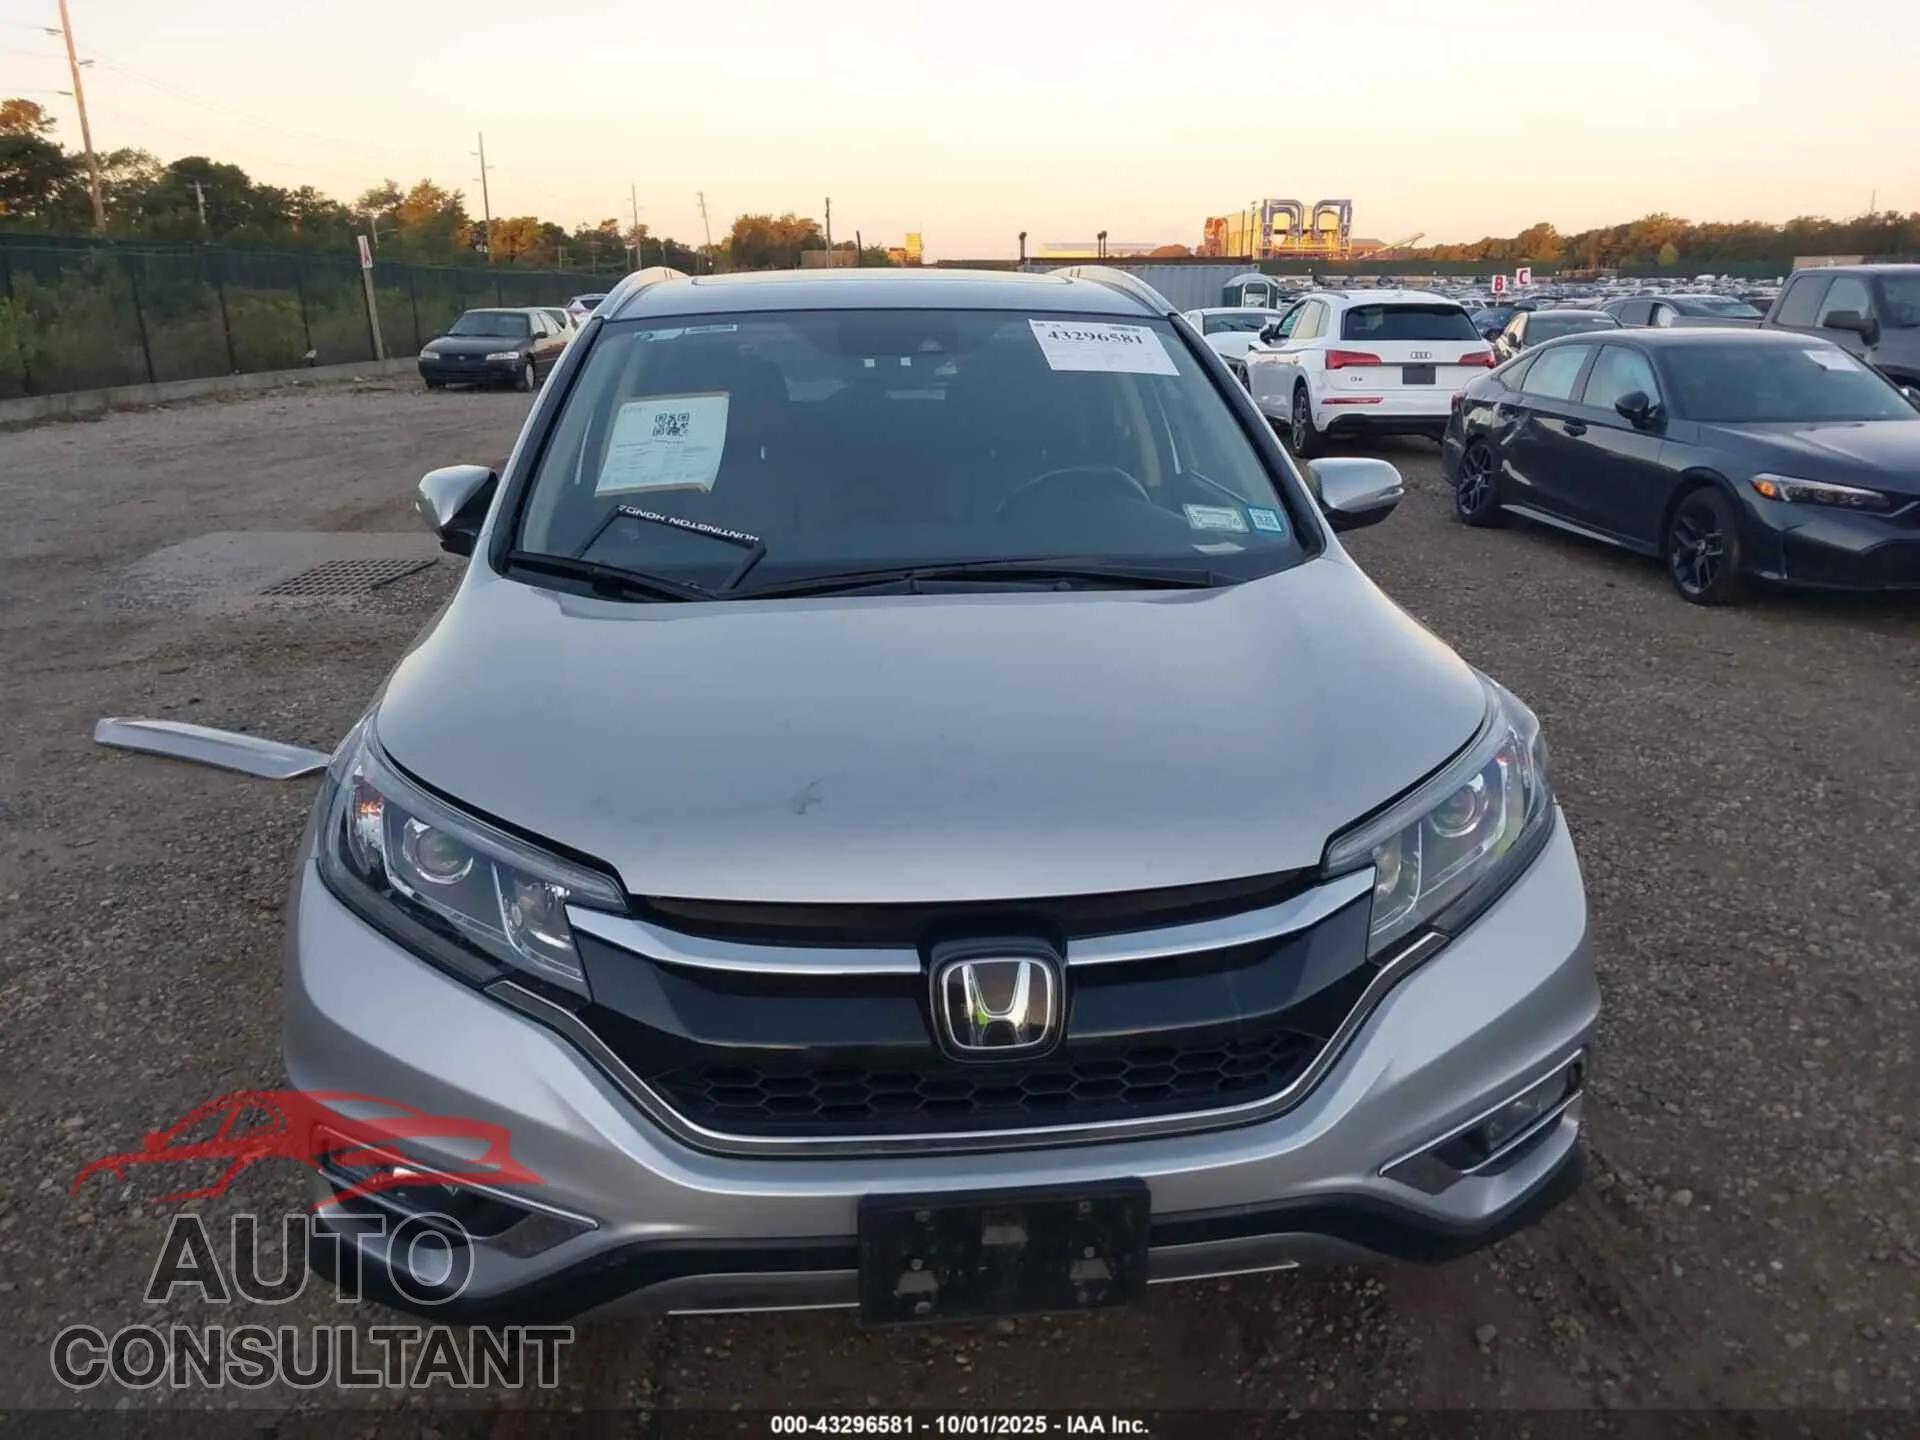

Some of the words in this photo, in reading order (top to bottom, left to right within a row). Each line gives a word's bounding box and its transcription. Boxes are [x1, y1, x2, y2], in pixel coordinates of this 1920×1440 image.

[1495, 276, 1503, 291] B
[1519, 270, 1528, 284] C
[1048, 330, 1143, 345] 43296581
[617, 504, 666, 521] HONDA
[670, 517, 760, 542] HUNTINGTON
